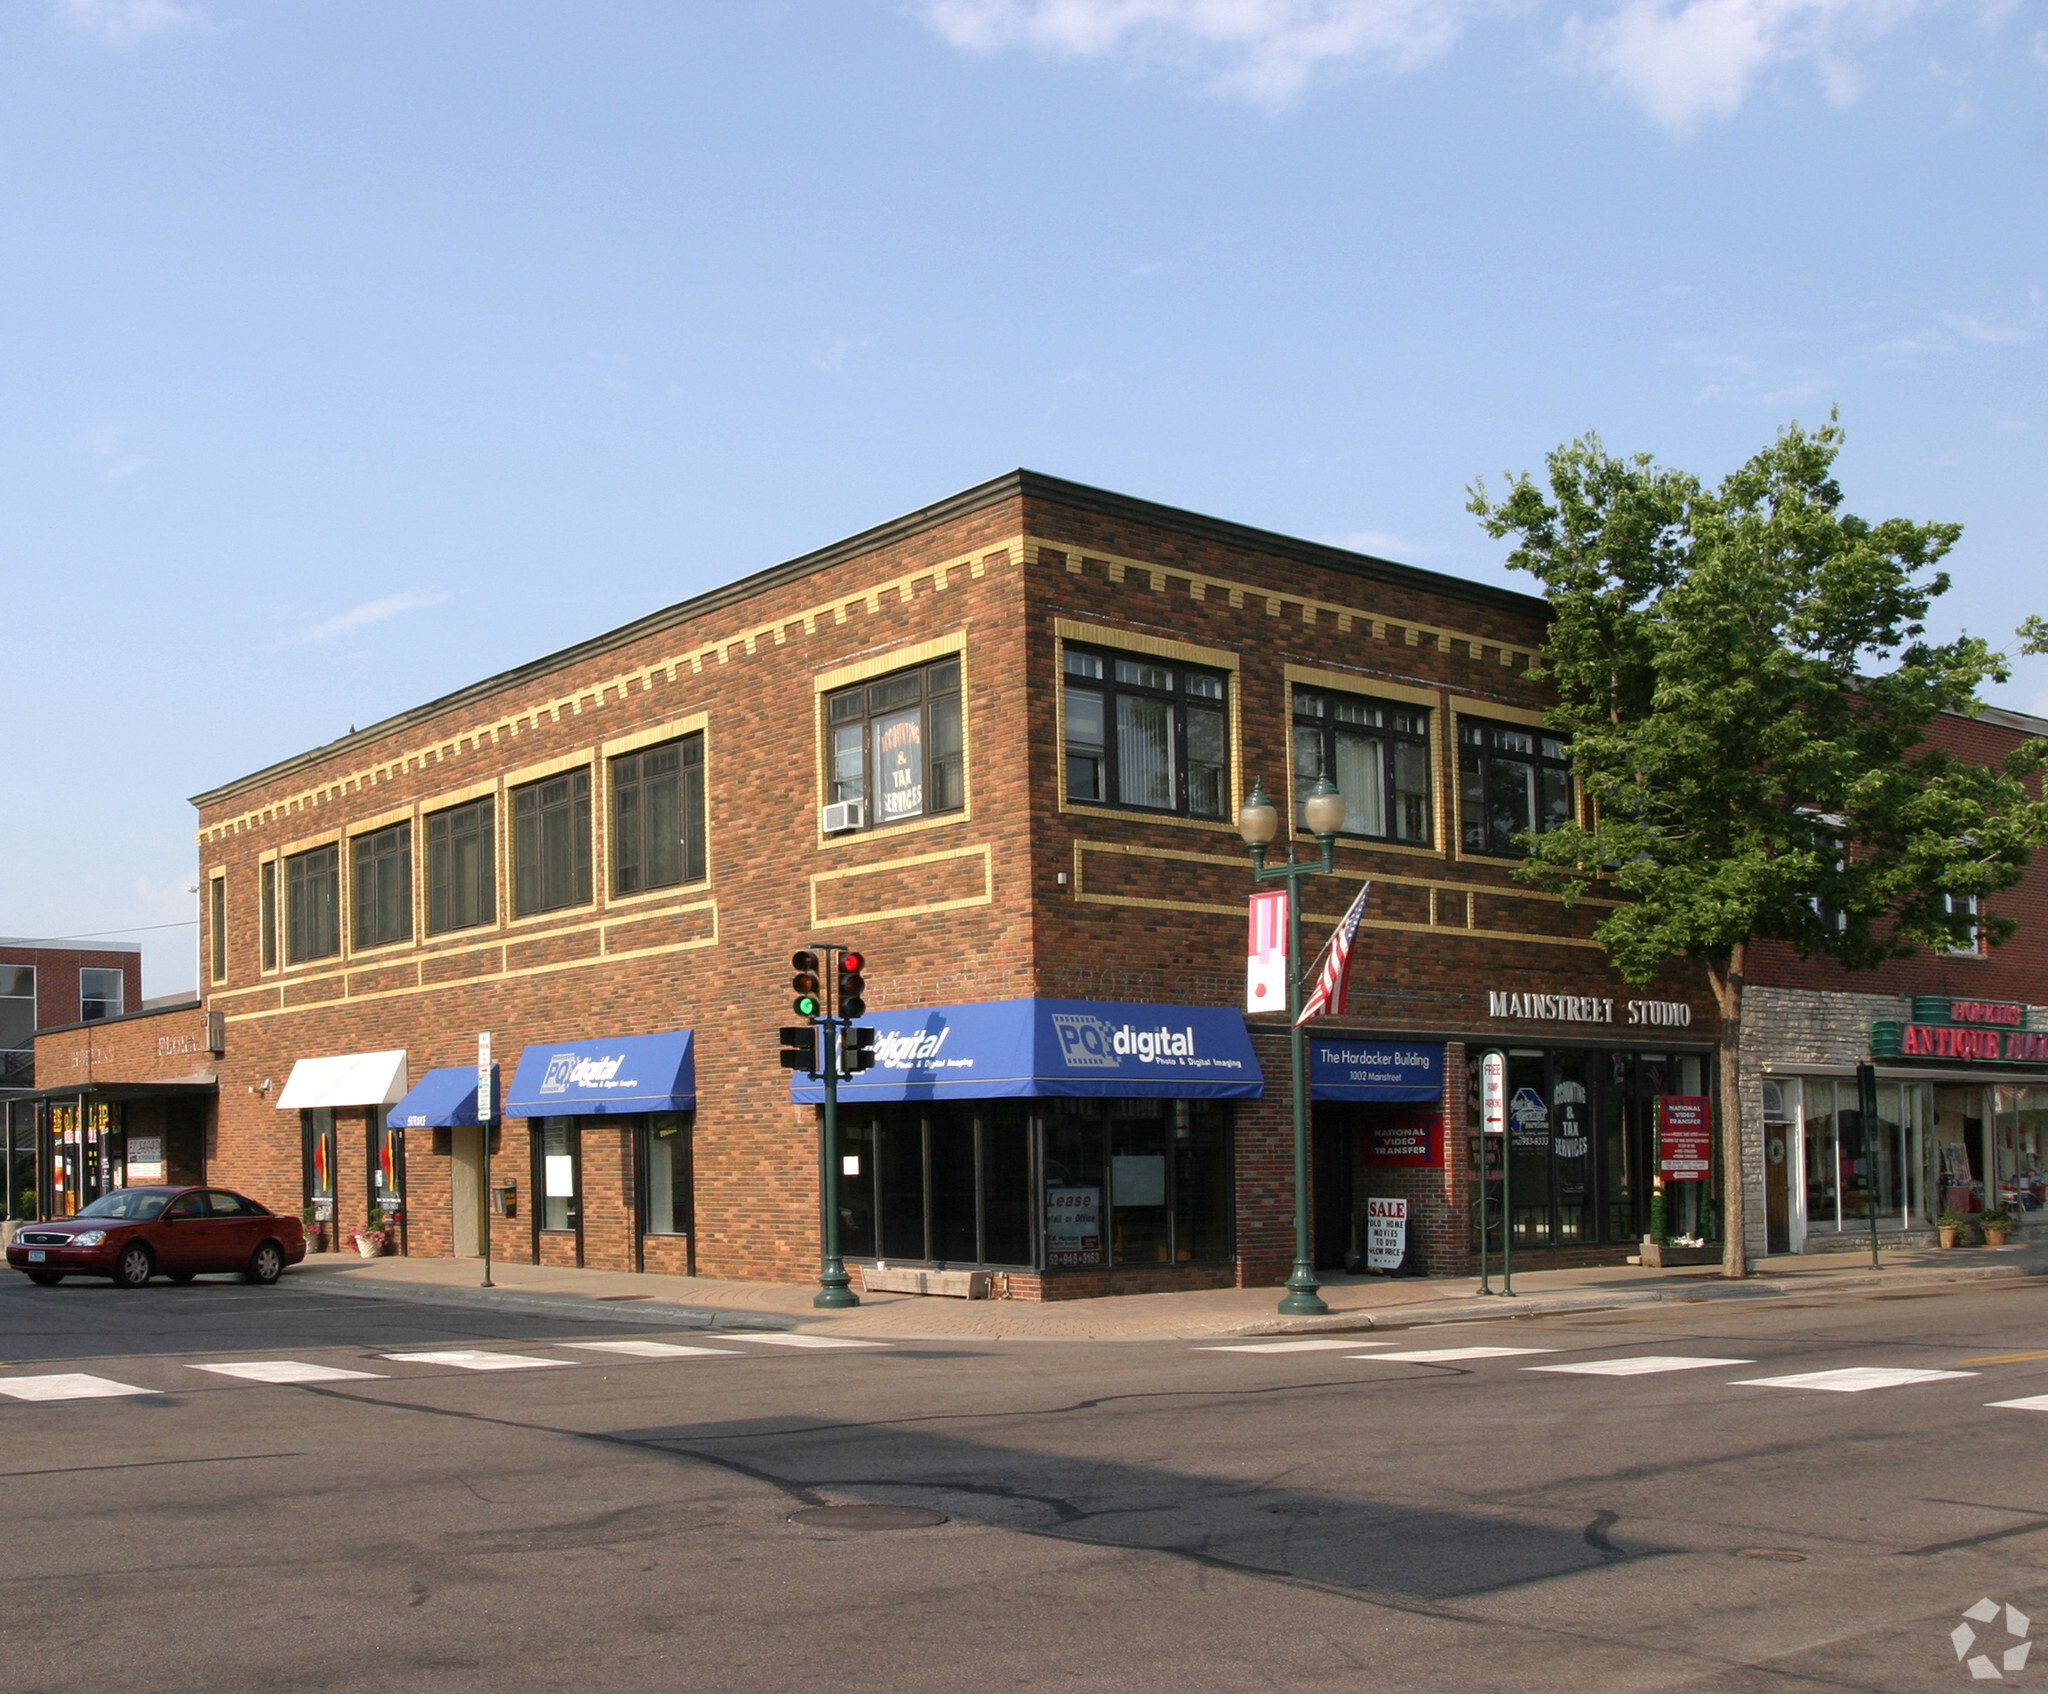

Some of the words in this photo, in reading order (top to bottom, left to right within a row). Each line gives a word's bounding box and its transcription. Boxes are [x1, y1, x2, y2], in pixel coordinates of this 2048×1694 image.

[897, 751, 907, 765] &
[892, 768, 912, 787] TAX
[883, 784, 922, 812] SERVICES
[1489, 991, 1614, 1023] MAINSTREET
[1628, 999, 1691, 1026] STUDIO
[1951, 1001, 2021, 1025] HOPKINS
[874, 1027, 950, 1068] digital
[1058, 1024, 1107, 1059] PQ
[1113, 1024, 1195, 1063] digital
[1902, 1024, 2000, 1062] ANTIQUE
[924, 1059, 945, 1069] Digital
[947, 1058, 974, 1067] Imaging
[1155, 1056, 1176, 1066] Photo
[1179, 1057, 1186, 1065] &
[1188, 1057, 1211, 1068] Digital
[1213, 1058, 1242, 1068] Imaging
[1320, 1049, 1339, 1064] The
[1342, 1050, 1392, 1065] Hardacker
[1394, 1051, 1430, 1069] Building
[545, 1061, 570, 1084] PQ
[570, 1054, 625, 1087] digital
[1350, 1071, 1366, 1080] 1002
[1368, 1072, 1402, 1082] Mainstreet
[1484, 1064, 1501, 1076] FREE
[1566, 1106, 1575, 1119] &
[1374, 1128, 1426, 1137] NATIONAL
[1562, 1121, 1579, 1137] TAX
[1384, 1137, 1416, 1146] VIDEO
[1555, 1137, 1588, 1158] SERVICES
[1375, 1146, 1426, 1155] TRANSFER
[1047, 1192, 1091, 1207] Lease
[1369, 1202, 1405, 1218] SALE
[1075, 1214, 1095, 1223] Office
[1386, 1220, 1404, 1228] HOME
[1373, 1229, 1398, 1238] MOVIES
[1376, 1238, 1383, 1246] TO
[1385, 1239, 1397, 1247] DVD
[1384, 1248, 1400, 1256] PRICE
